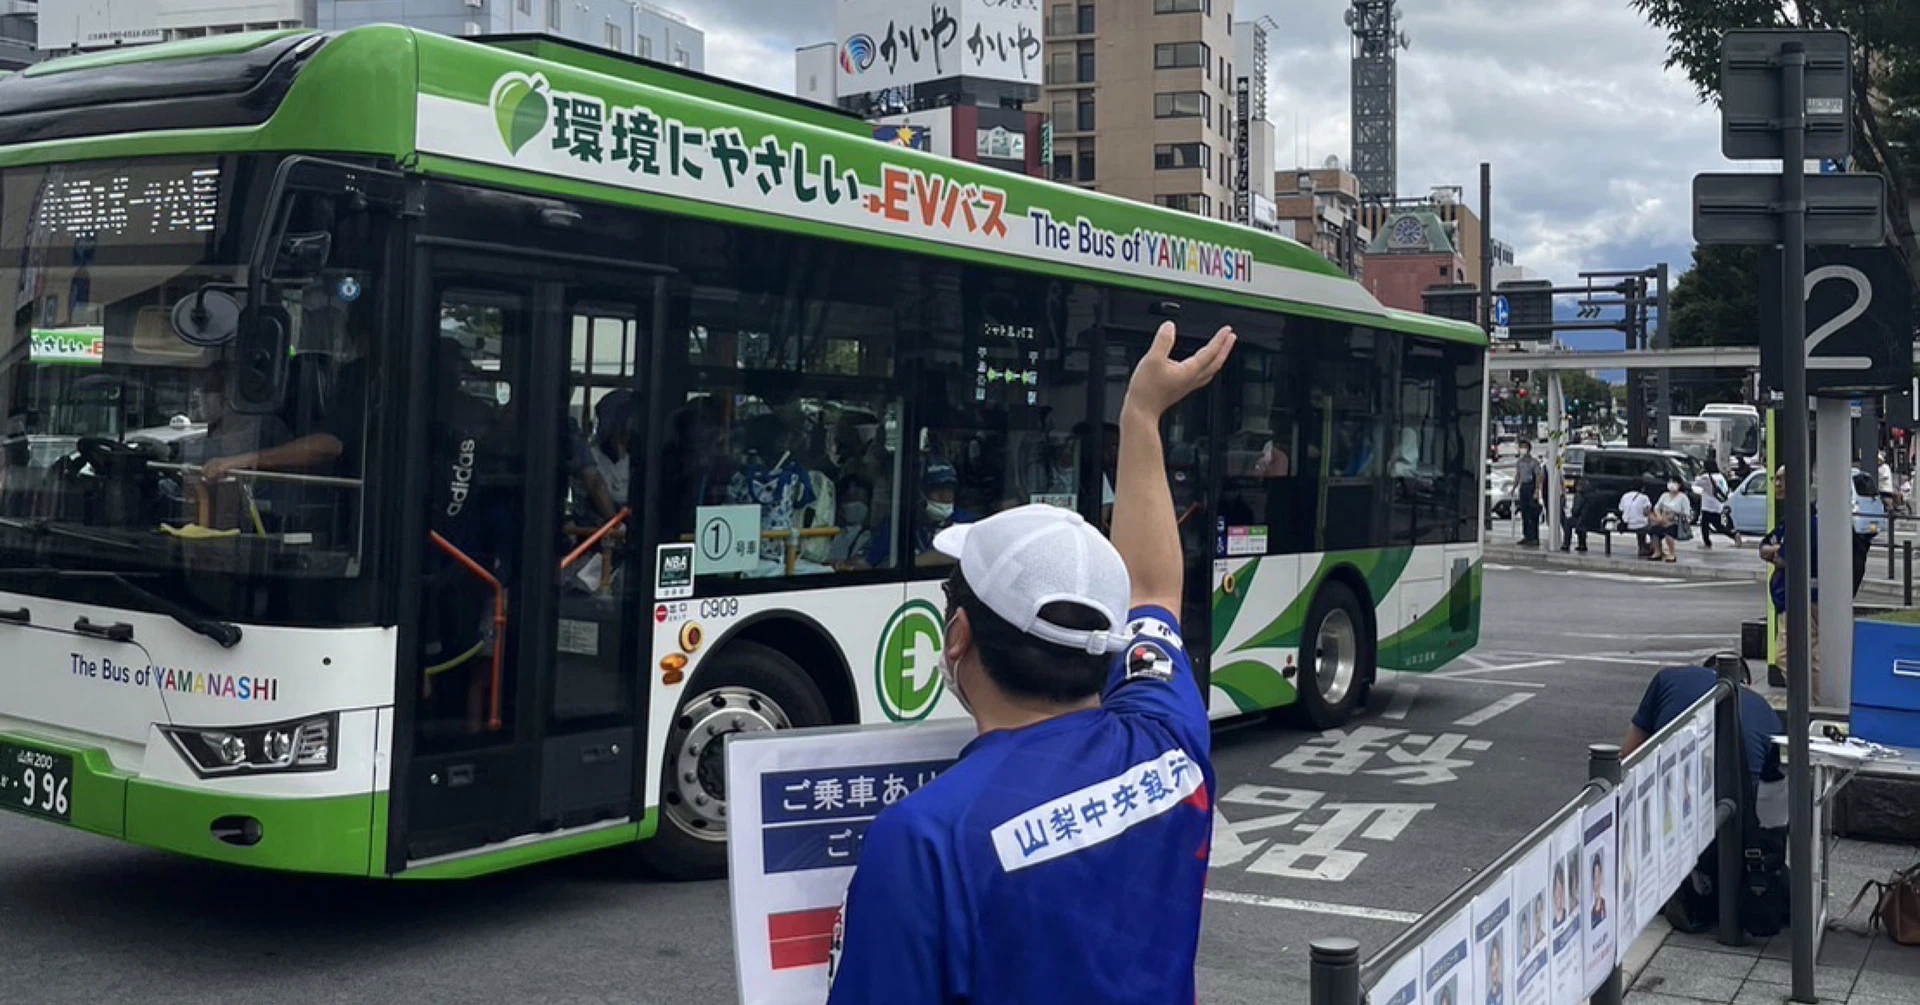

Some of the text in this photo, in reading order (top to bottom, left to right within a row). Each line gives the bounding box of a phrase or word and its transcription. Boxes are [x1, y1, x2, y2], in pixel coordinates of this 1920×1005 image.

[880, 3, 958, 75] かいや
[967, 22, 1041, 79] かいや
[552, 96, 1008, 240] 環境にやさしい EVバス
[1030, 211, 1253, 284] The Bus of YAMANASHI
[1803, 263, 1874, 370] 2
[446, 438, 476, 517] adidas
[700, 596, 739, 619] C909
[71, 652, 278, 702] The Bus of YAMANASHI
